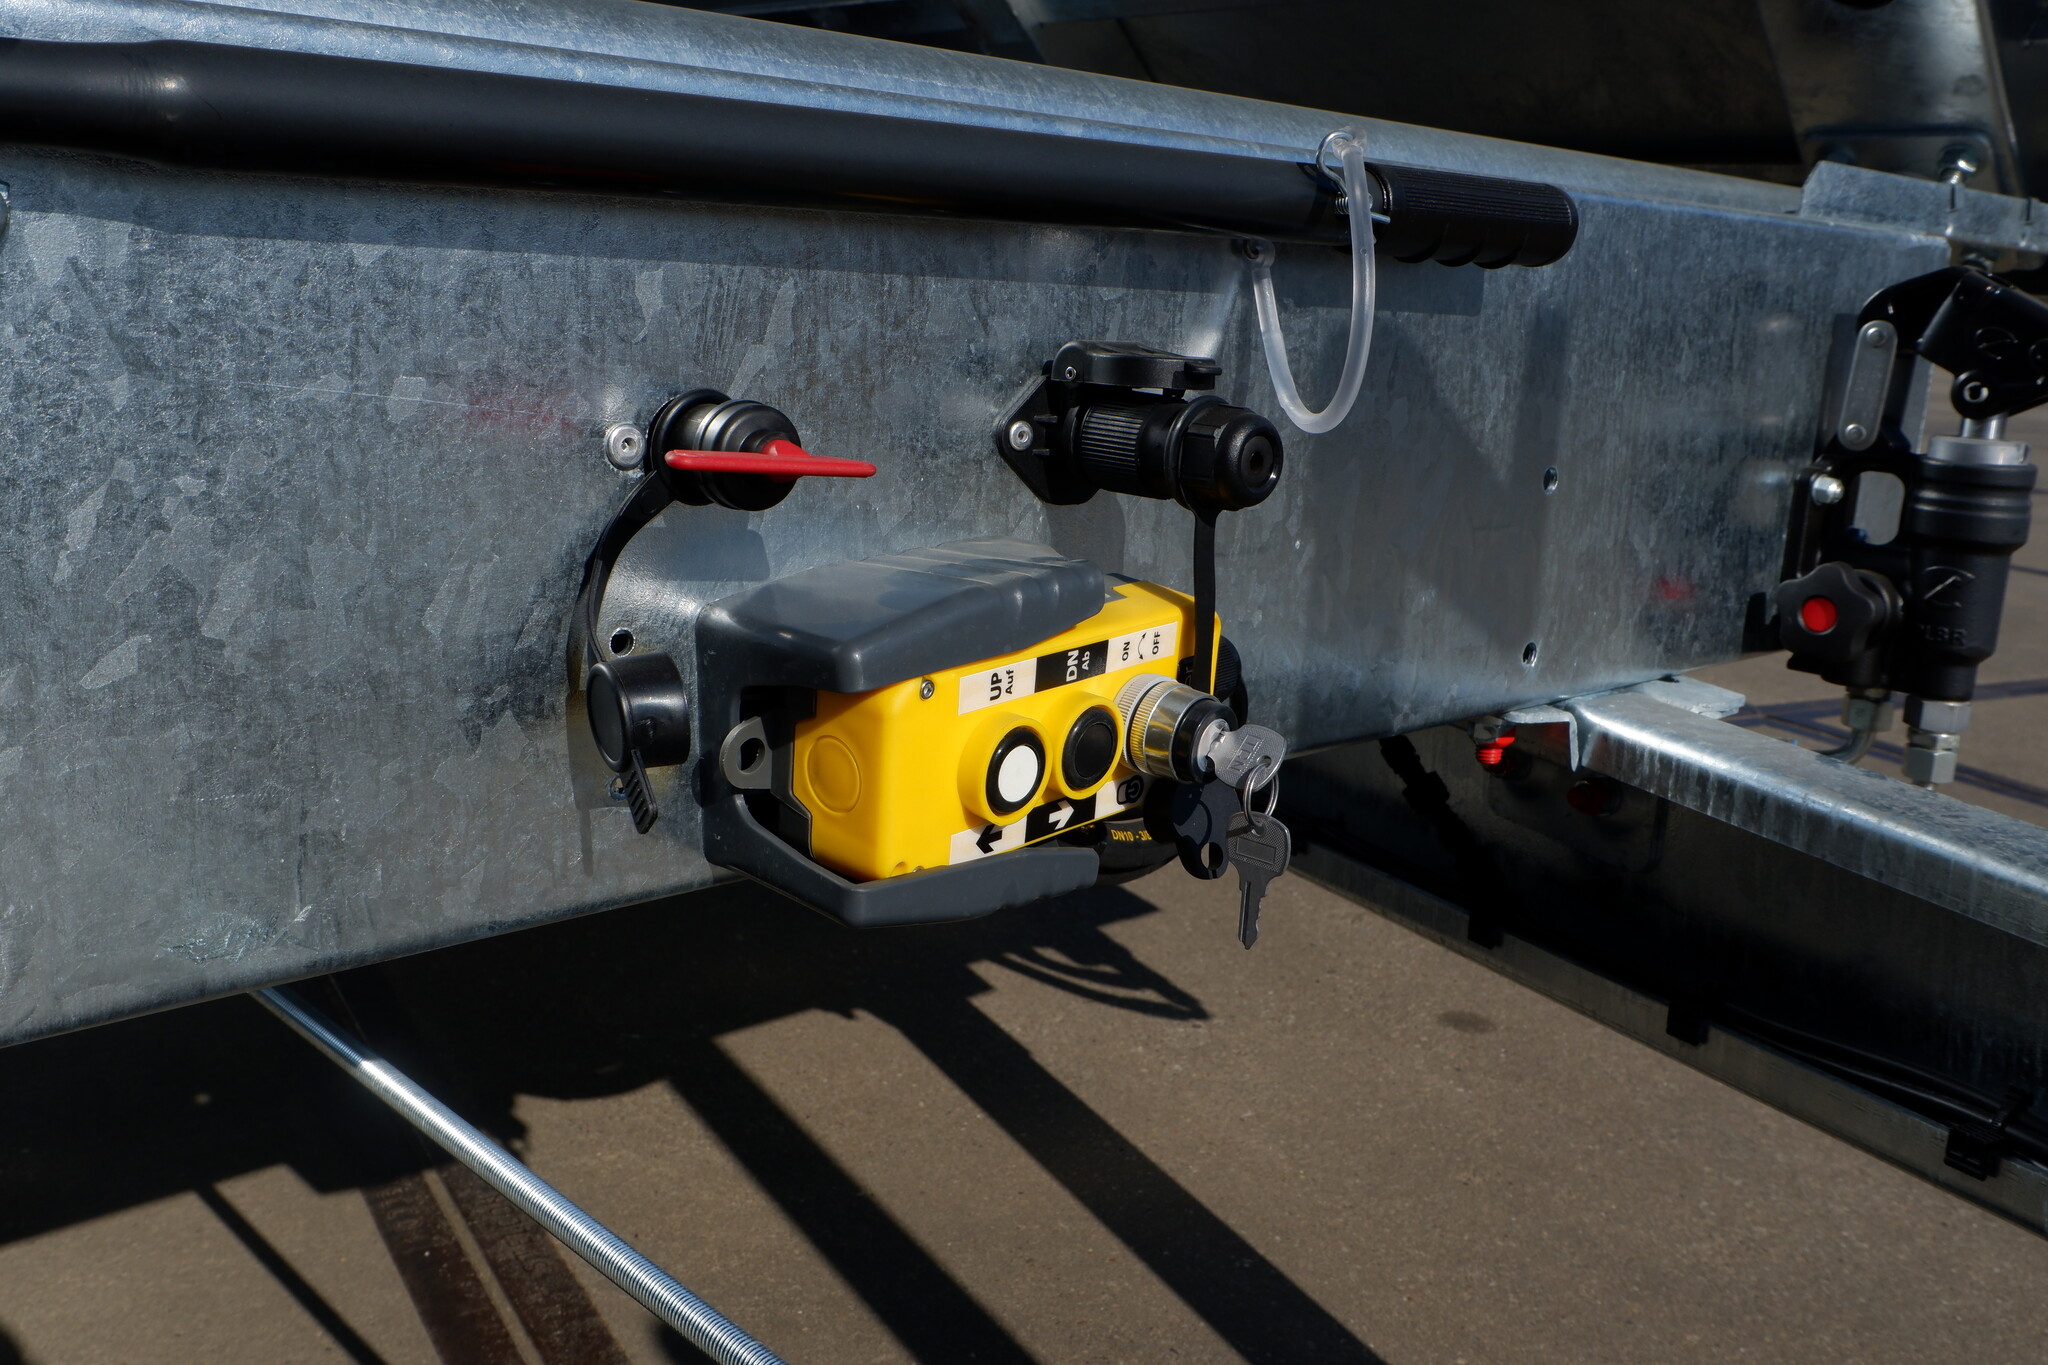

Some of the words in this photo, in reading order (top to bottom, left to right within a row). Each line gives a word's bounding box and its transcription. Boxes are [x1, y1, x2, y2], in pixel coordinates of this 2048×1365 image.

[1121, 641, 1131, 661] ON
[1152, 631, 1161, 655] OFF
[1066, 649, 1080, 682] DN
[1081, 650, 1091, 671] Ab
[989, 672, 1003, 702] UP
[1005, 669, 1015, 695] Auf
[1111, 829, 1133, 842] DN10
